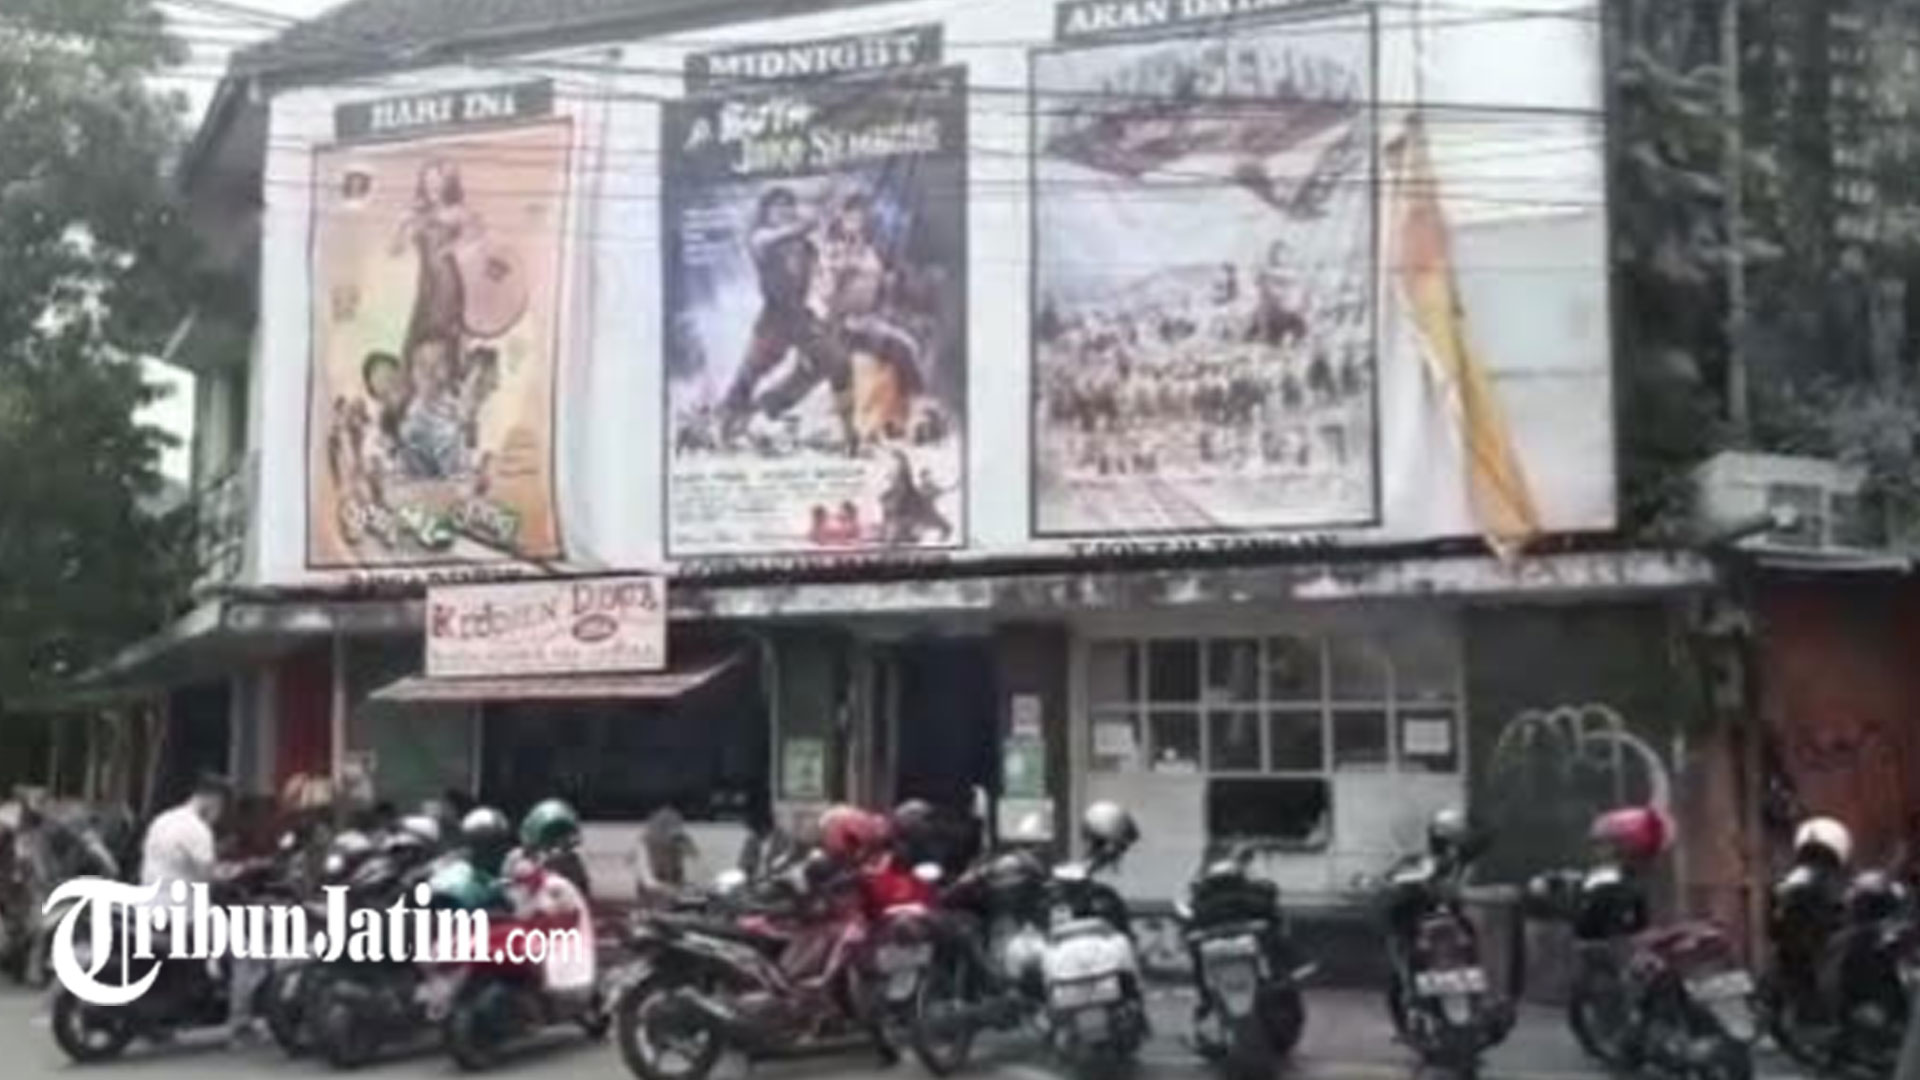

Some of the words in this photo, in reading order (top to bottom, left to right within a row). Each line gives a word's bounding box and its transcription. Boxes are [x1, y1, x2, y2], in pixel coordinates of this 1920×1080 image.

[708, 34, 919, 77] MIDNIGHT
[369, 98, 453, 130] HARI
[461, 92, 516, 120] INI
